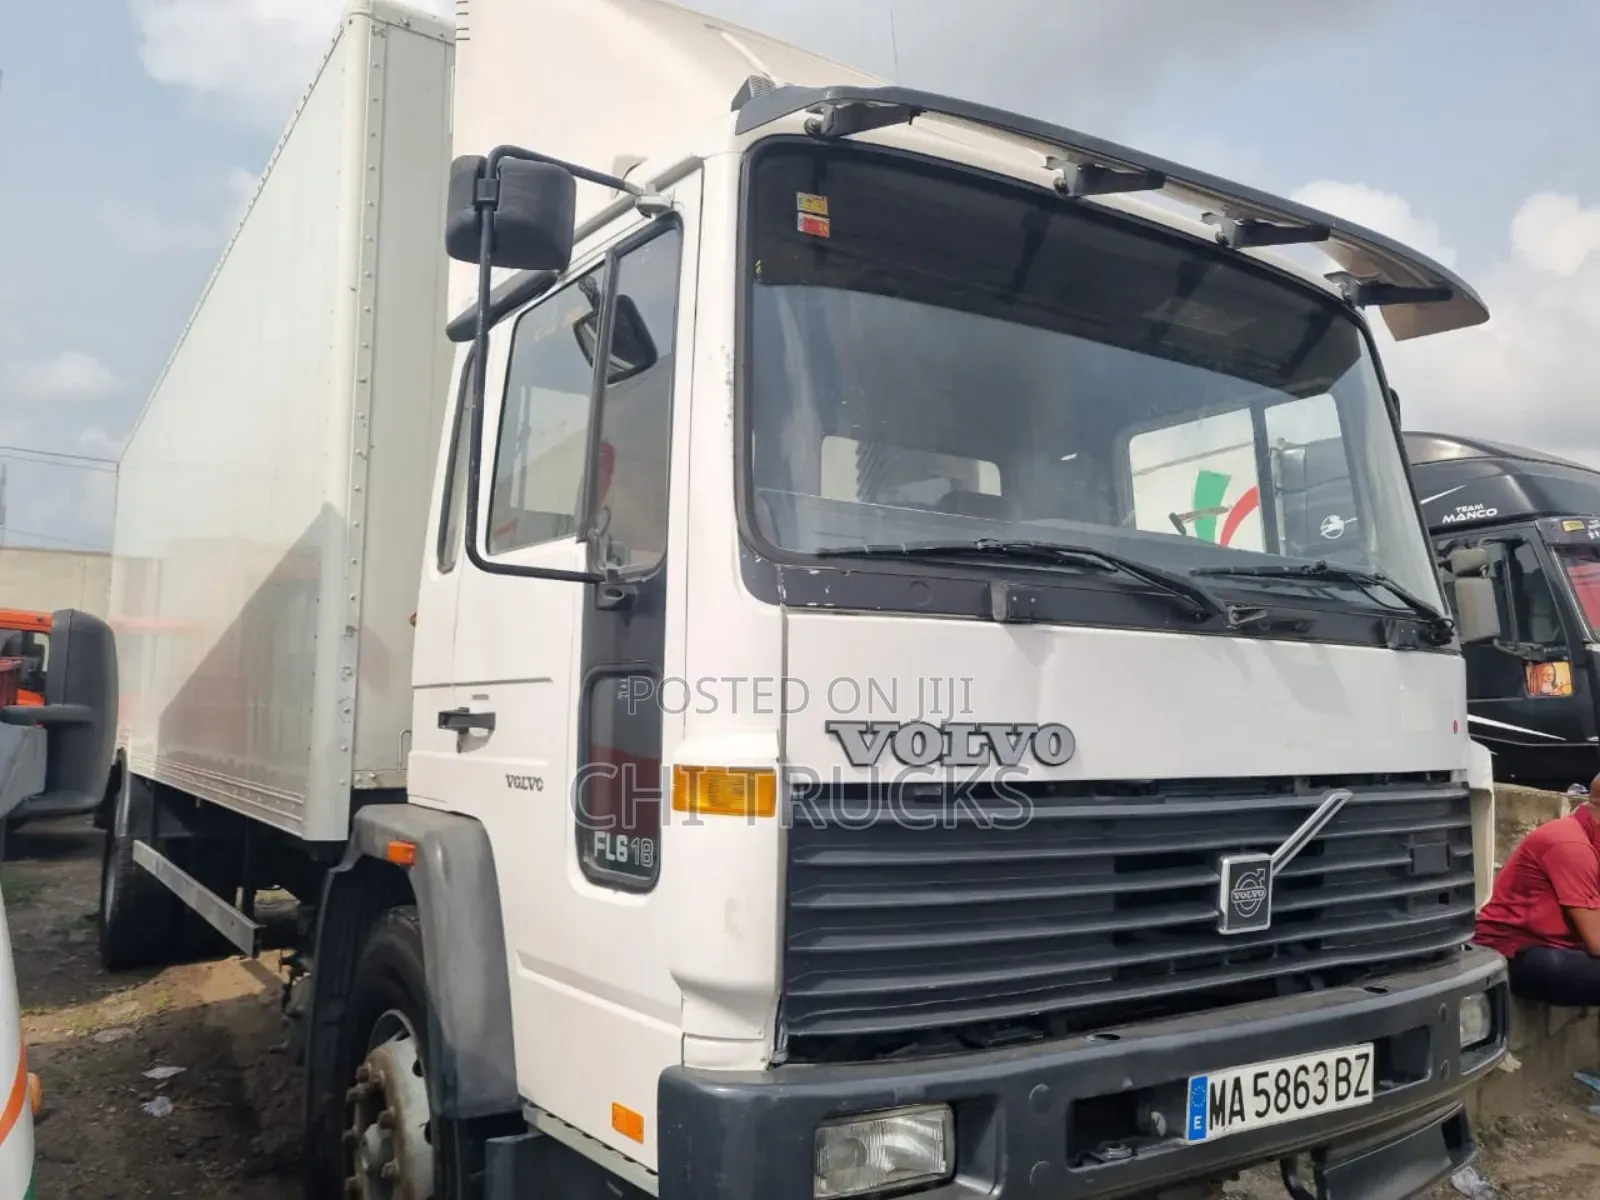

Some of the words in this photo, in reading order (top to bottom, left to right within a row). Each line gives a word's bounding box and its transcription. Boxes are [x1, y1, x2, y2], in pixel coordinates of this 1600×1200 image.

[1456, 503, 1484, 513] TEAM
[1442, 508, 1498, 524] MANCO
[825, 720, 1076, 767] VOLVO
[505, 774, 544, 792] VOLVO
[1233, 889, 1265, 900] VOLVO
[1193, 1115, 1202, 1130] E
